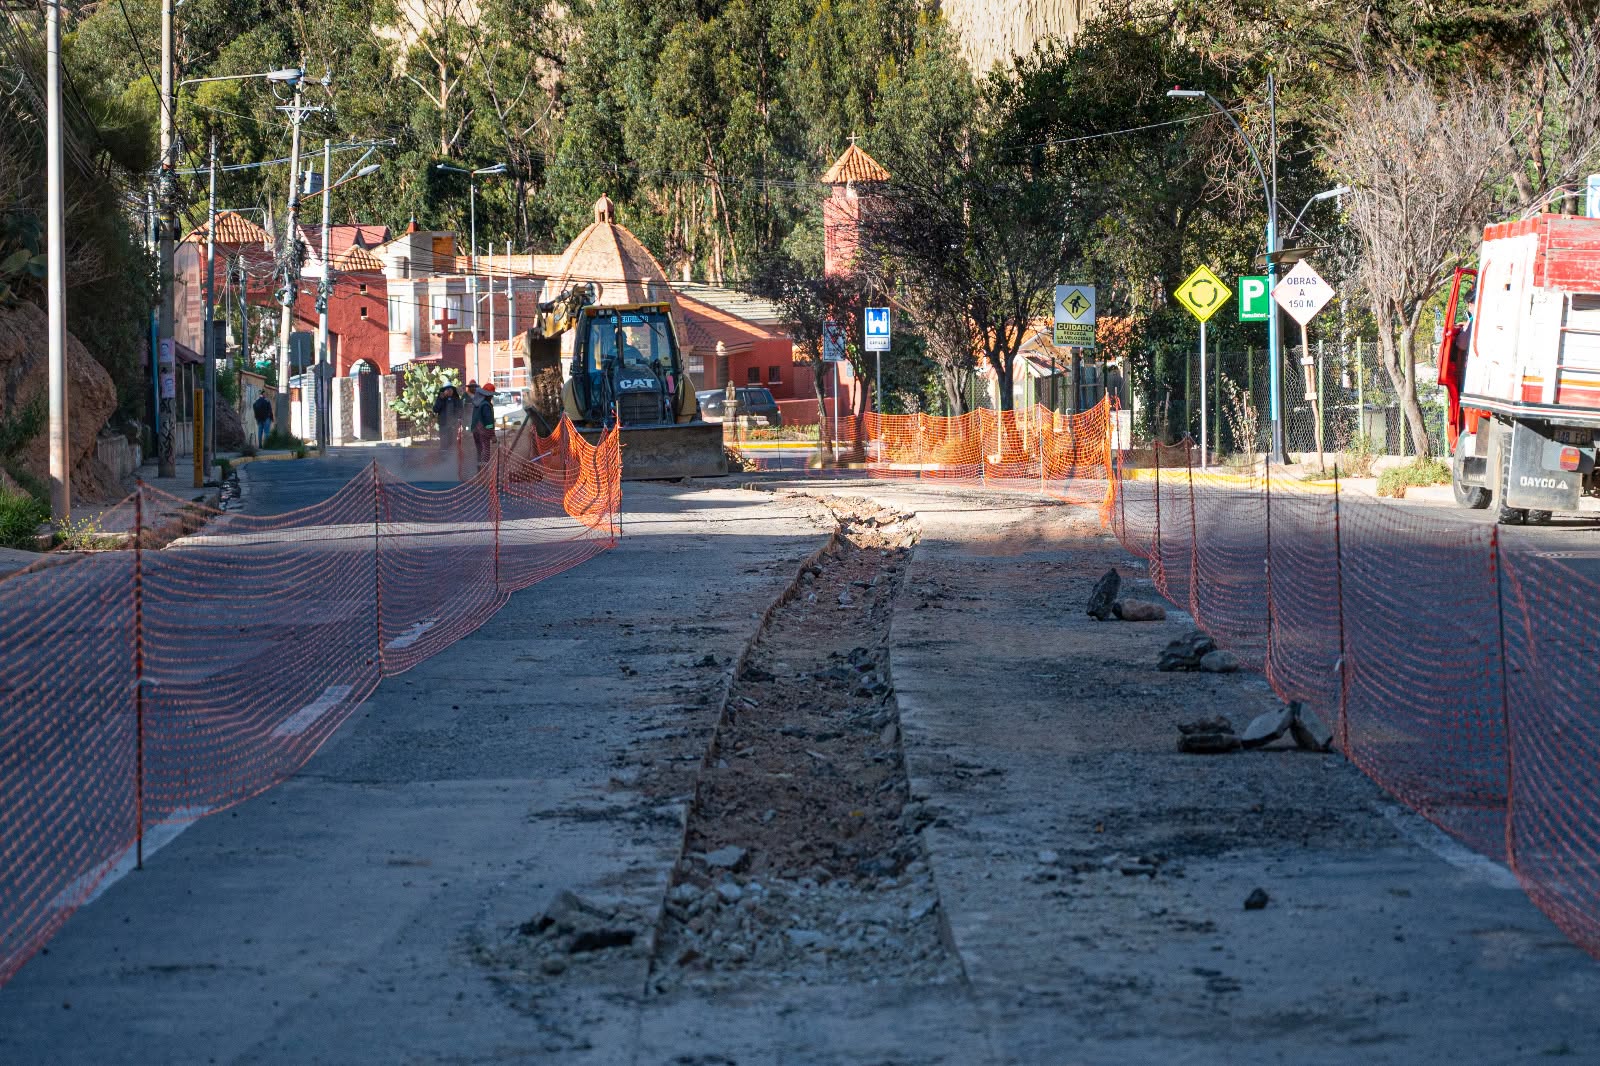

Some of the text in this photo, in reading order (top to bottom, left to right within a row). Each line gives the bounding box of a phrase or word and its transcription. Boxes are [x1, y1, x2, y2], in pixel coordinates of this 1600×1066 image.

[1286, 277, 1317, 285] OBRAS
[1242, 279, 1265, 312] P
[1299, 288, 1306, 297] A
[1288, 299, 1316, 308] 150 M.
[1057, 323, 1093, 332] CUIDADO
[619, 378, 655, 389] CAT
[1520, 476, 1556, 489] DAYCO
